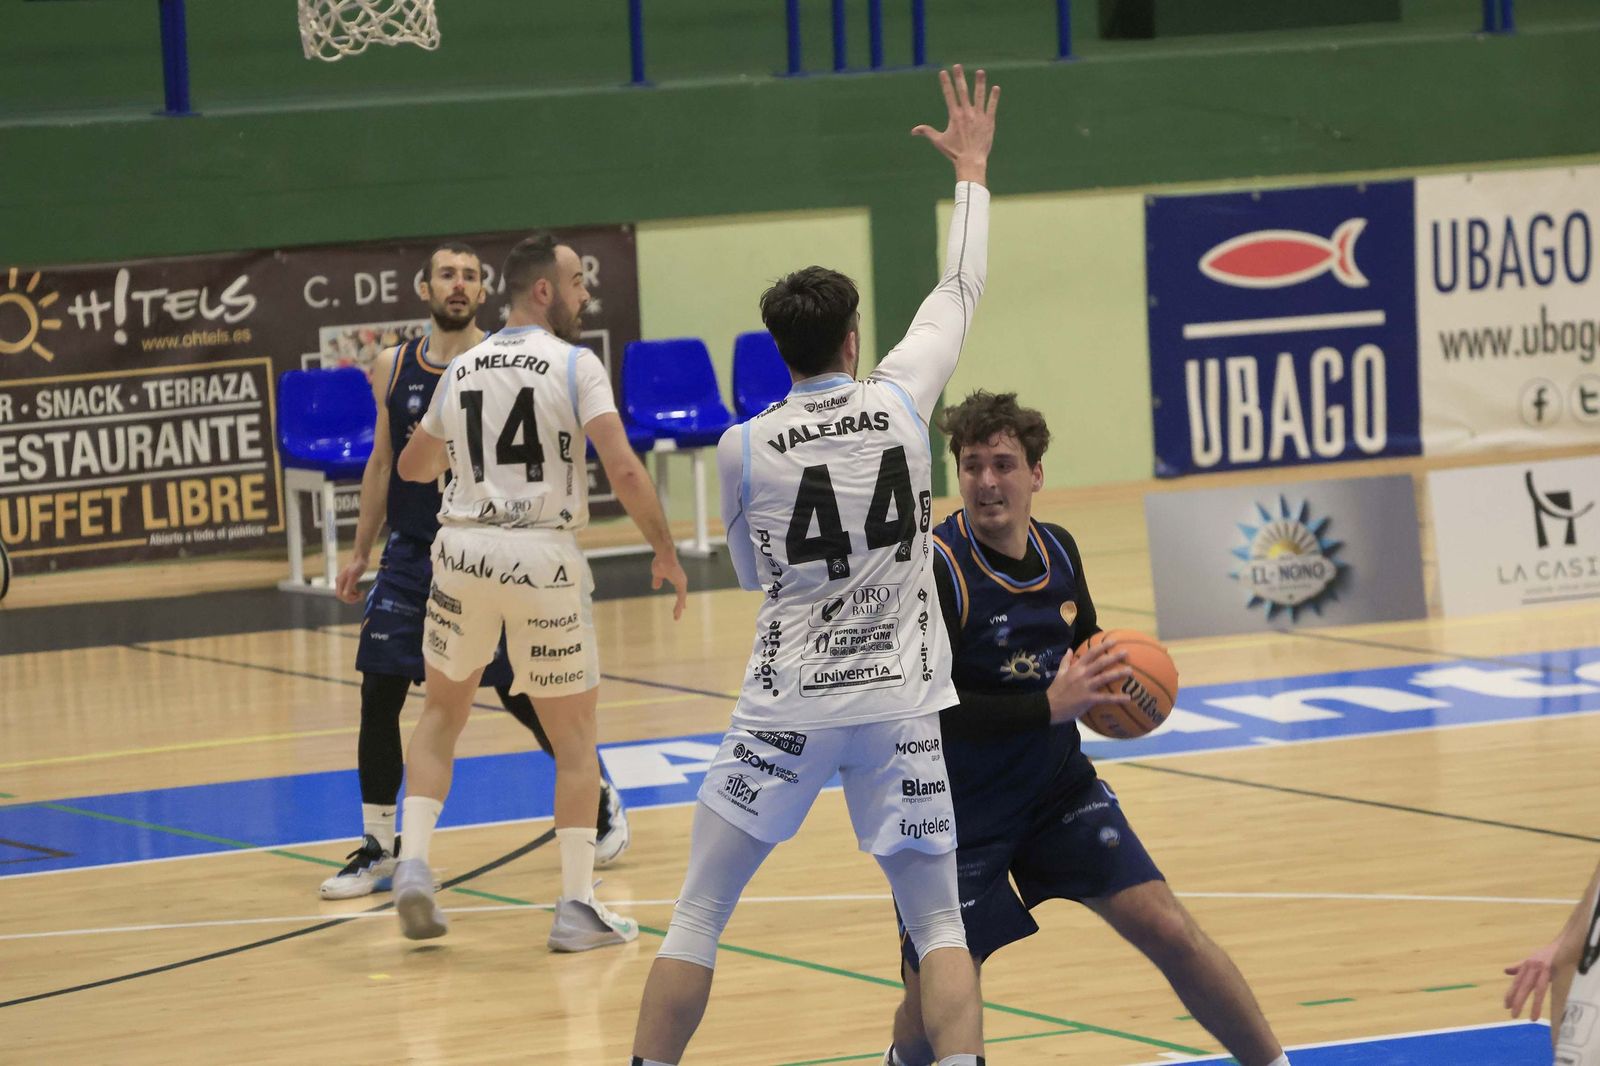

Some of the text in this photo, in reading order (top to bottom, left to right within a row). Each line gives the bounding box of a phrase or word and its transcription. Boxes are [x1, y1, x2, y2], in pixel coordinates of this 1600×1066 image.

[1432, 210, 1593, 294] UBAGO
[354, 270, 398, 305] DE
[141, 328, 251, 351] www.ohtels.es
[1439, 304, 1600, 364] www.ubag
[474, 354, 551, 376] MELERO
[36, 383, 125, 420] SNACK
[143, 371, 258, 410] TERRAZA
[1185, 344, 1388, 468] UBAGO
[0, 414, 264, 482] ESTAURANTE
[460, 387, 544, 483] 14
[767, 411, 890, 454] VALEIRAS
[0, 473, 269, 545] UFFET LIBRE
[786, 445, 917, 581] 44
[1497, 563, 1529, 586] LA
[852, 587, 890, 604] ORO
[527, 613, 578, 630] MONGAR
[835, 632, 892, 646] LA FORTUNA
[530, 642, 582, 658] Blanca
[895, 739, 940, 755] MONGAR
[902, 778, 946, 796] Blanca
